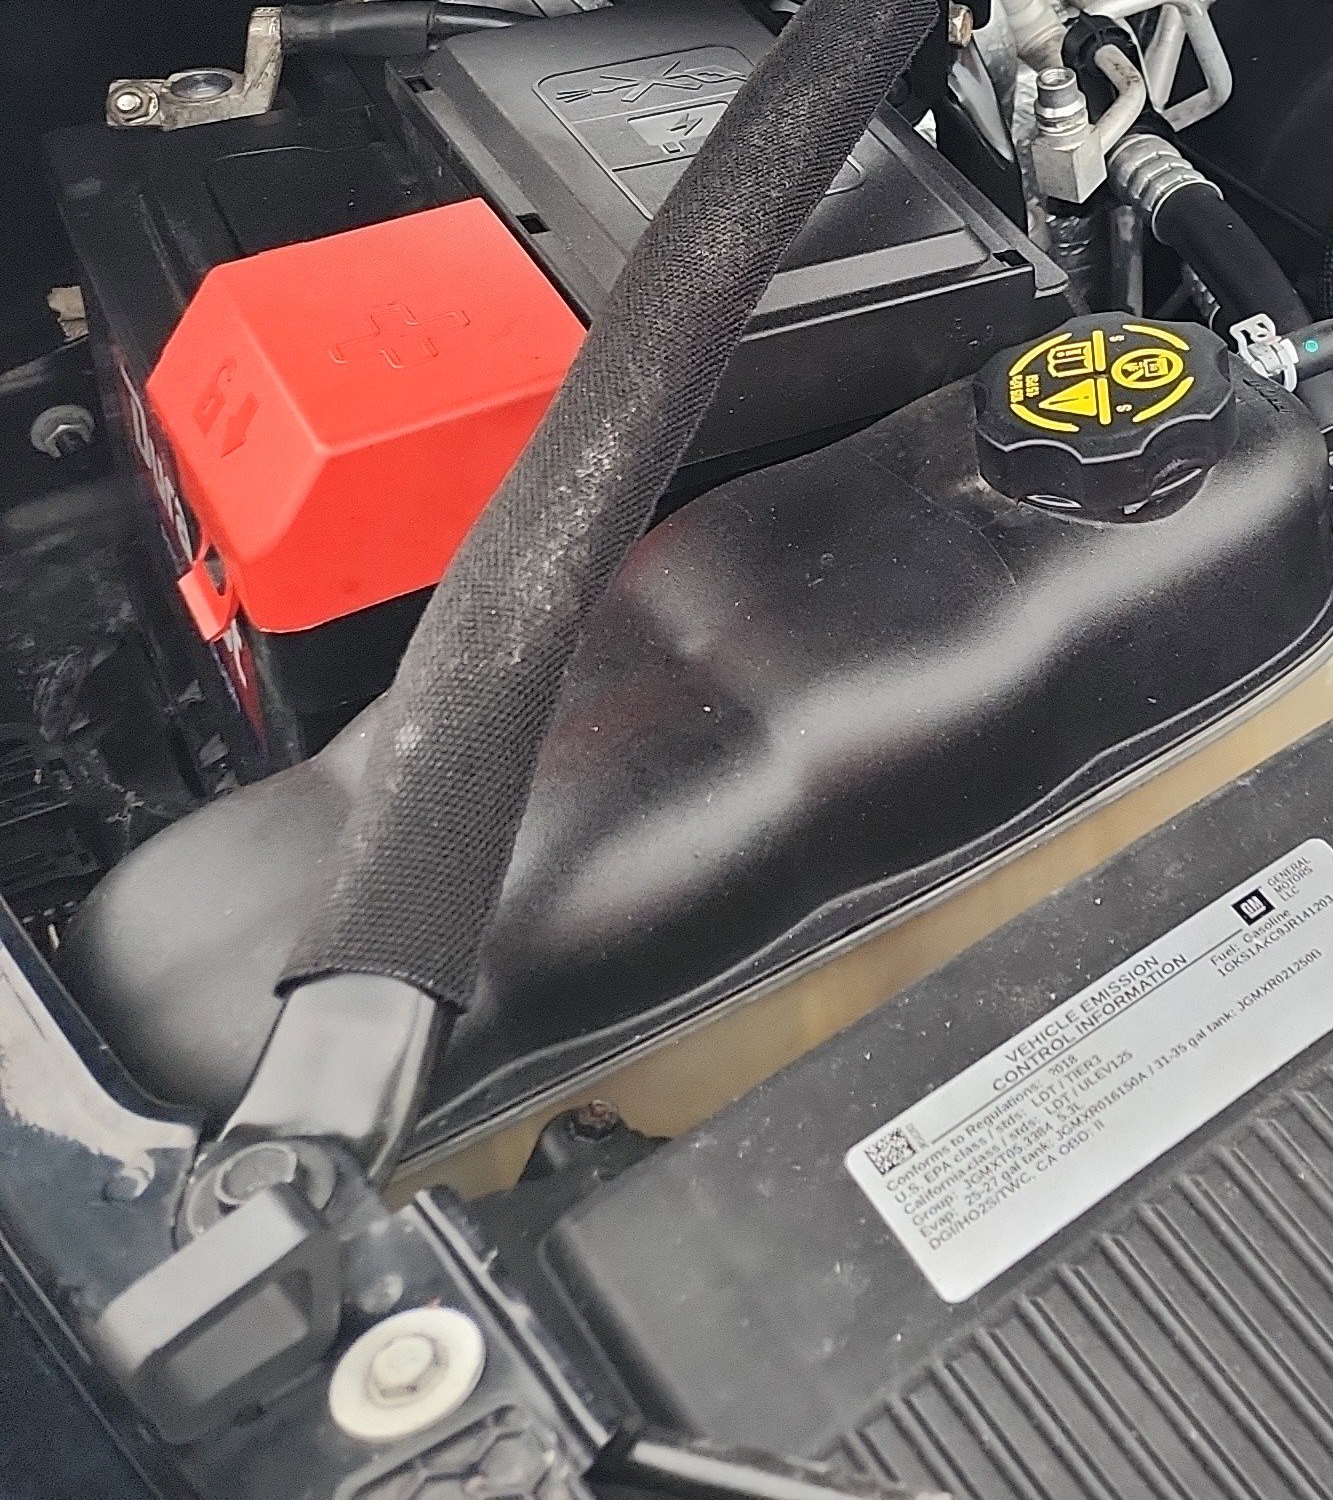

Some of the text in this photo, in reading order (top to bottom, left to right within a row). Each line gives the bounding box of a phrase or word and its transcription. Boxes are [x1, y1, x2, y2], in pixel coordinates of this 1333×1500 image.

[1265, 854, 1312, 888] GENERAL
[1272, 864, 1314, 895] MOTORS
[1279, 884, 1300, 902] LLC
[1208, 906, 1292, 967] Fuel: Gasoline
[989, 952, 1189, 1093] CONTROL INFORMATION
[1003, 954, 1161, 1065] VEHICLE EMISSION
[884, 1143, 951, 1193] Conforms
[948, 1133, 965, 1149] to
[963, 1078, 1045, 1139] Regulations:
[1048, 1053, 1080, 1078] 2018
[892, 1179, 923, 1205] U.S.
[922, 1157, 954, 1184] EPA
[950, 1133, 988, 1164] class
[992, 1105, 1028, 1135] stds:
[1030, 1084, 1059, 1108] LDT
[1063, 1052, 1104, 1084] TIER3
[900, 1165, 968, 1217] California
[964, 1141, 1002, 1172] class
[1005, 1113, 1042, 1142] stds:
[1043, 1091, 1073, 1116] LDT
[1075, 1048, 1135, 1093] ULEV125
[917, 1205, 960, 1241] Evap:
[962, 1176, 1001, 1207] 25-27
[998, 1159, 1025, 1183] gal
[1019, 1136, 1056, 1166] tank:
[1152, 1041, 1189, 1070] 31-35
[1185, 1027, 1209, 1049] gal
[1205, 1006, 1238, 1033] tank:
[1033, 1151, 1059, 1174] CA
[909, 1188, 961, 1230] Group:
